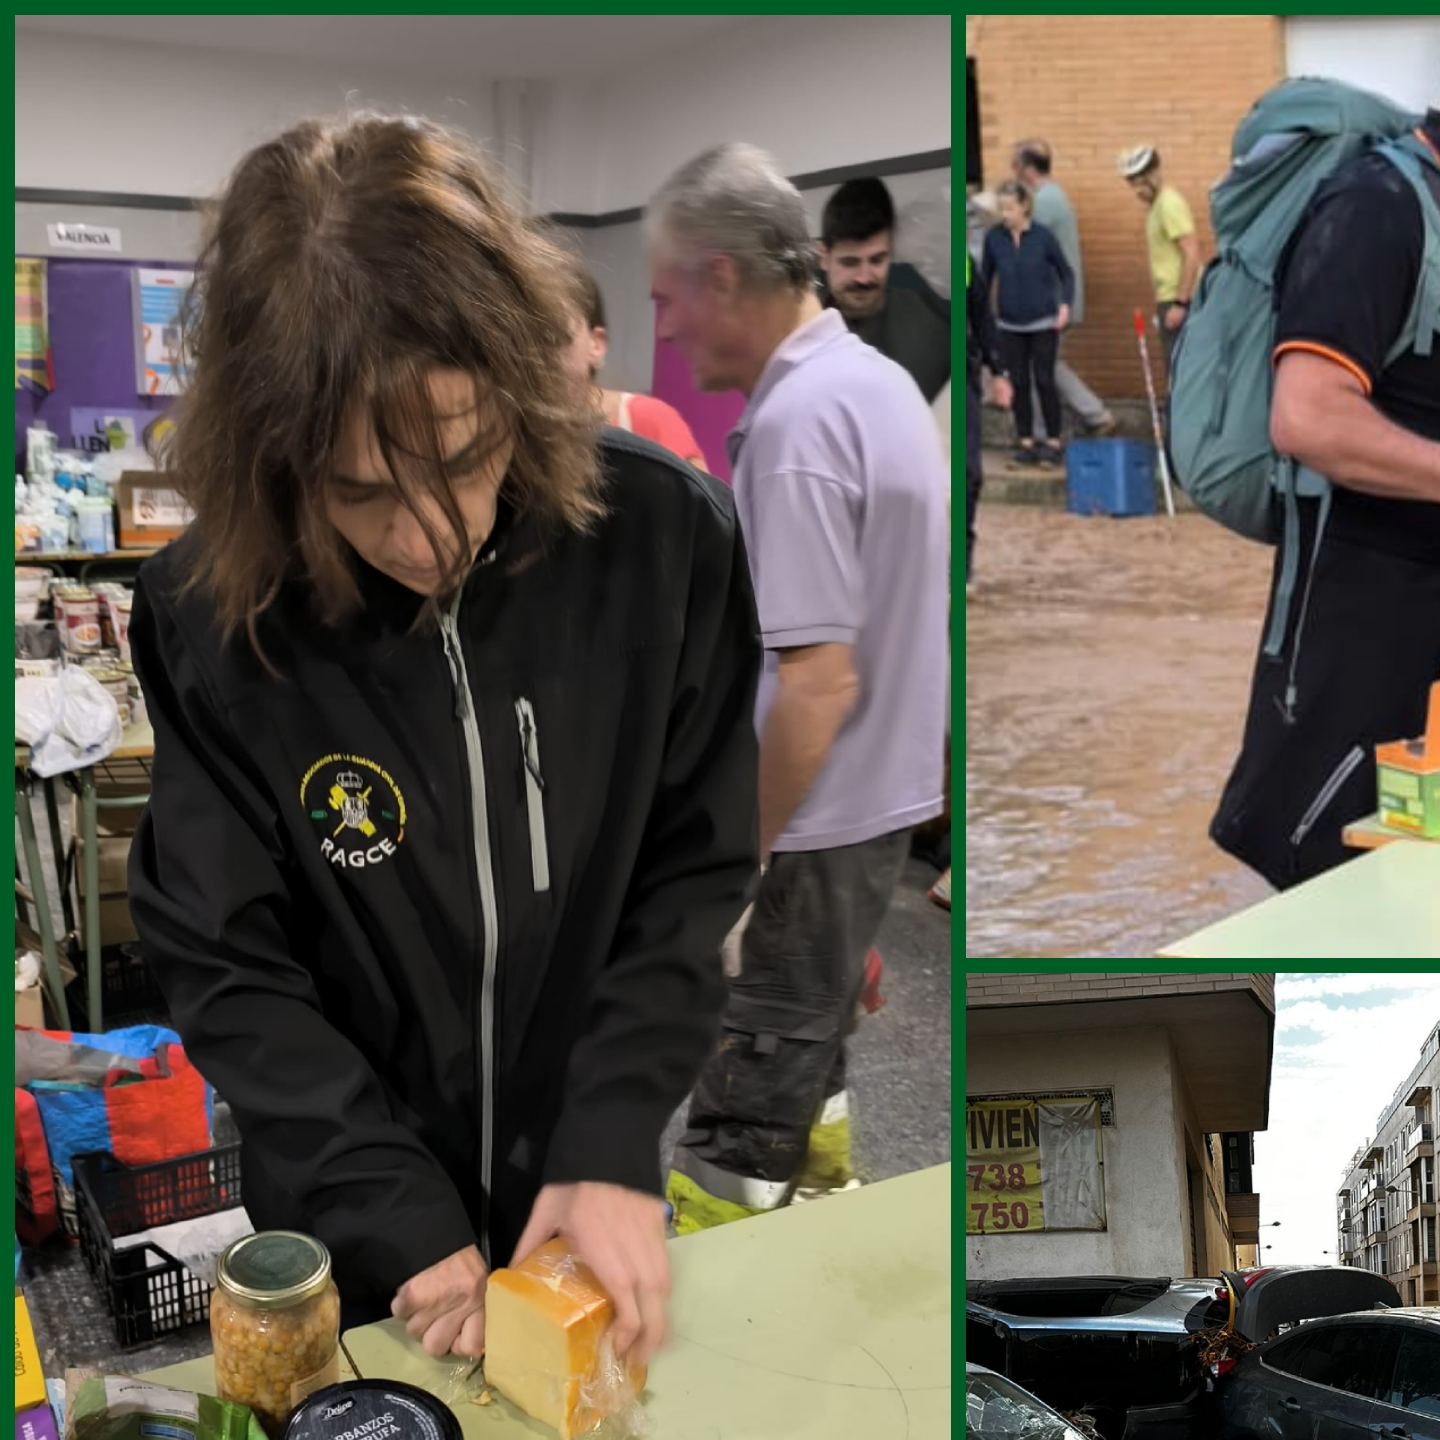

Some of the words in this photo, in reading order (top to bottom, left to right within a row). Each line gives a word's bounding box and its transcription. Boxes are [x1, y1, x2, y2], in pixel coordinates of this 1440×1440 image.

[321, 837, 398, 868] RAGCE
[966, 1108, 1040, 1150] IVIEN
[968, 1162, 1027, 1192] 738
[971, 1201, 1030, 1230] 750
[324, 1400, 354, 1419] Deluxe
